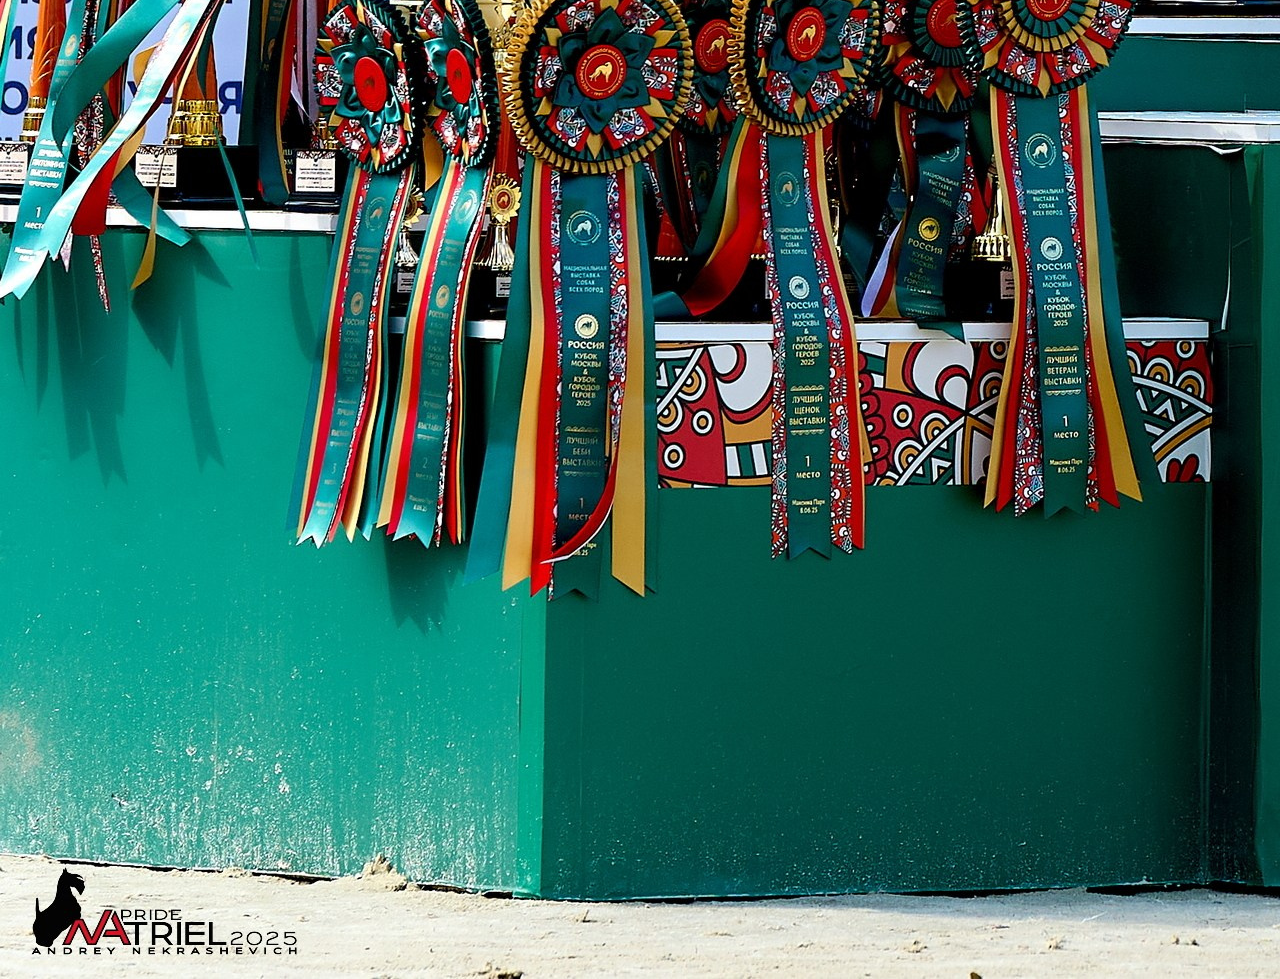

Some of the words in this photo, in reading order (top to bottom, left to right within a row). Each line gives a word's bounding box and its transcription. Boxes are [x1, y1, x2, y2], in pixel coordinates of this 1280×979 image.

[36, 207, 41, 218] 1
[908, 237, 943, 255] РОССИЯ
[1037, 263, 1072, 271] РОССИЯ
[786, 301, 819, 309] РОССИЯ
[568, 341, 604, 349] РОССИЯ
[1046, 354, 1078, 363] ЛУЧШИЙ
[1044, 377, 1082, 386] ВЫСТАВКИ
[792, 394, 823, 403] ЛУЧШИЙ
[794, 406, 820, 414] ЩЕНОК
[789, 417, 826, 425] ВЫСТАВКИ
[1062, 415, 1068, 427] 1
[423, 458, 427, 468] 2
[806, 456, 810, 467] 1
